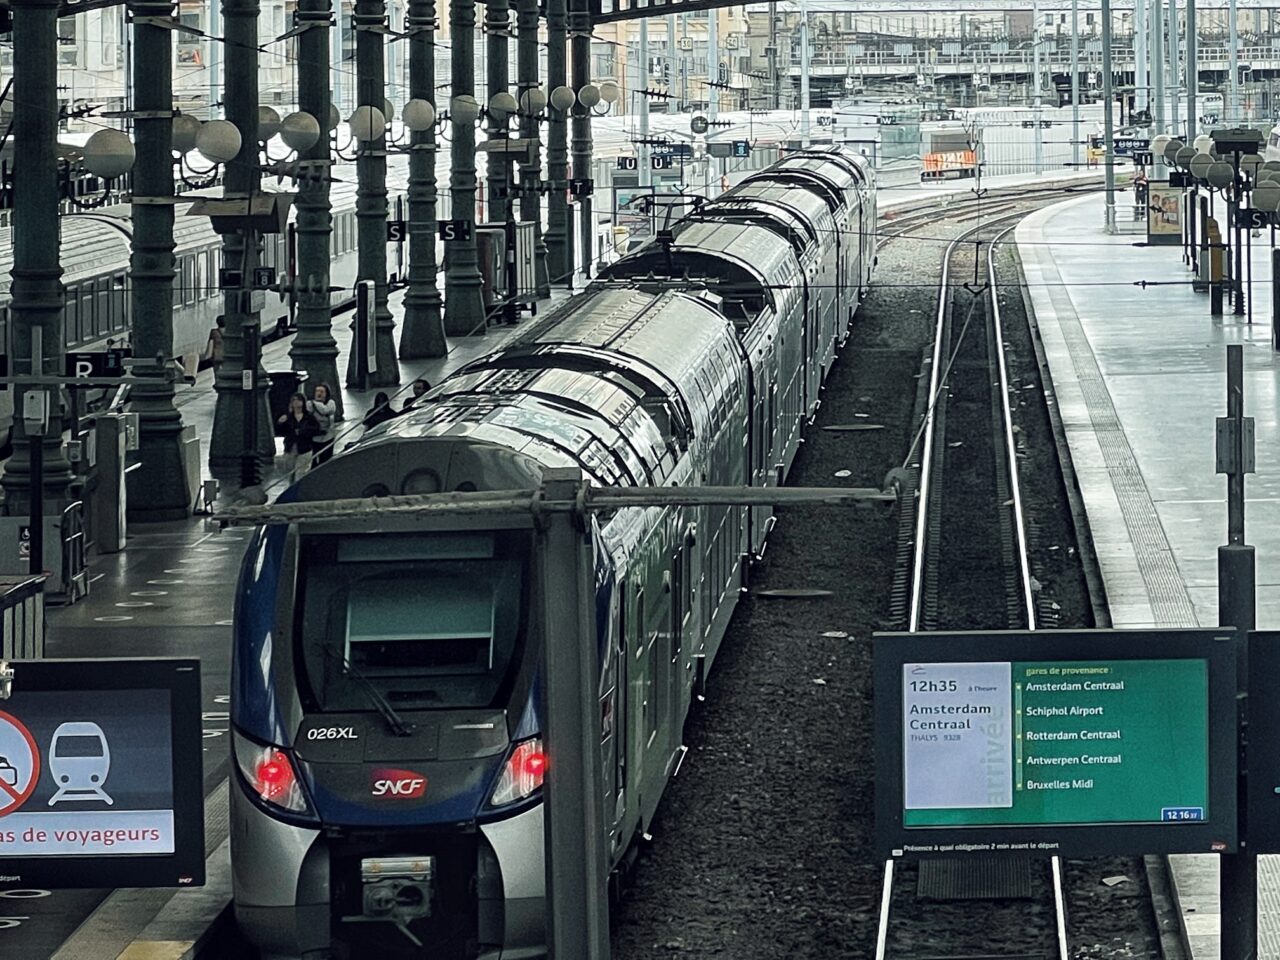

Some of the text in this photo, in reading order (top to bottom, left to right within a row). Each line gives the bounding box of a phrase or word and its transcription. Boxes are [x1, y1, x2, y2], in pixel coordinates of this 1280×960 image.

[626, 158, 635, 170] U
[654, 157, 663, 169] U
[574, 182, 584, 193] T
[1252, 213, 1262, 228] S
[390, 224, 400, 241] S
[444, 224, 455, 240] S
[76, 361, 94, 386] R
[1049, 667, 1058, 675] de
[1062, 667, 1109, 676] provenance
[909, 680, 957, 692] 12h35
[1026, 681, 1125, 692] Amsterdam Centraal
[910, 703, 991, 715] Amsterdam
[1026, 705, 1104, 718] Schiphol Airport
[910, 718, 972, 730] Centraal
[307, 727, 358, 740] 026XL
[1026, 729, 1121, 741] Rotterdam Centraal
[1026, 754, 1122, 767] Antwerpen Centraal
[371, 778, 424, 796] SNCF
[1027, 779, 1094, 790] Bruxelles Midi
[1167, 811, 1178, 820] 12
[1180, 811, 1190, 820] 16
[23, 827, 47, 843] de
[55, 828, 160, 846] voyageurs
[903, 843, 934, 852] Présence
[940, 843, 955, 852] quai
[954, 842, 991, 852] obligatoire
[1010, 842, 1029, 850] avant
[1037, 841, 1060, 850] départ
